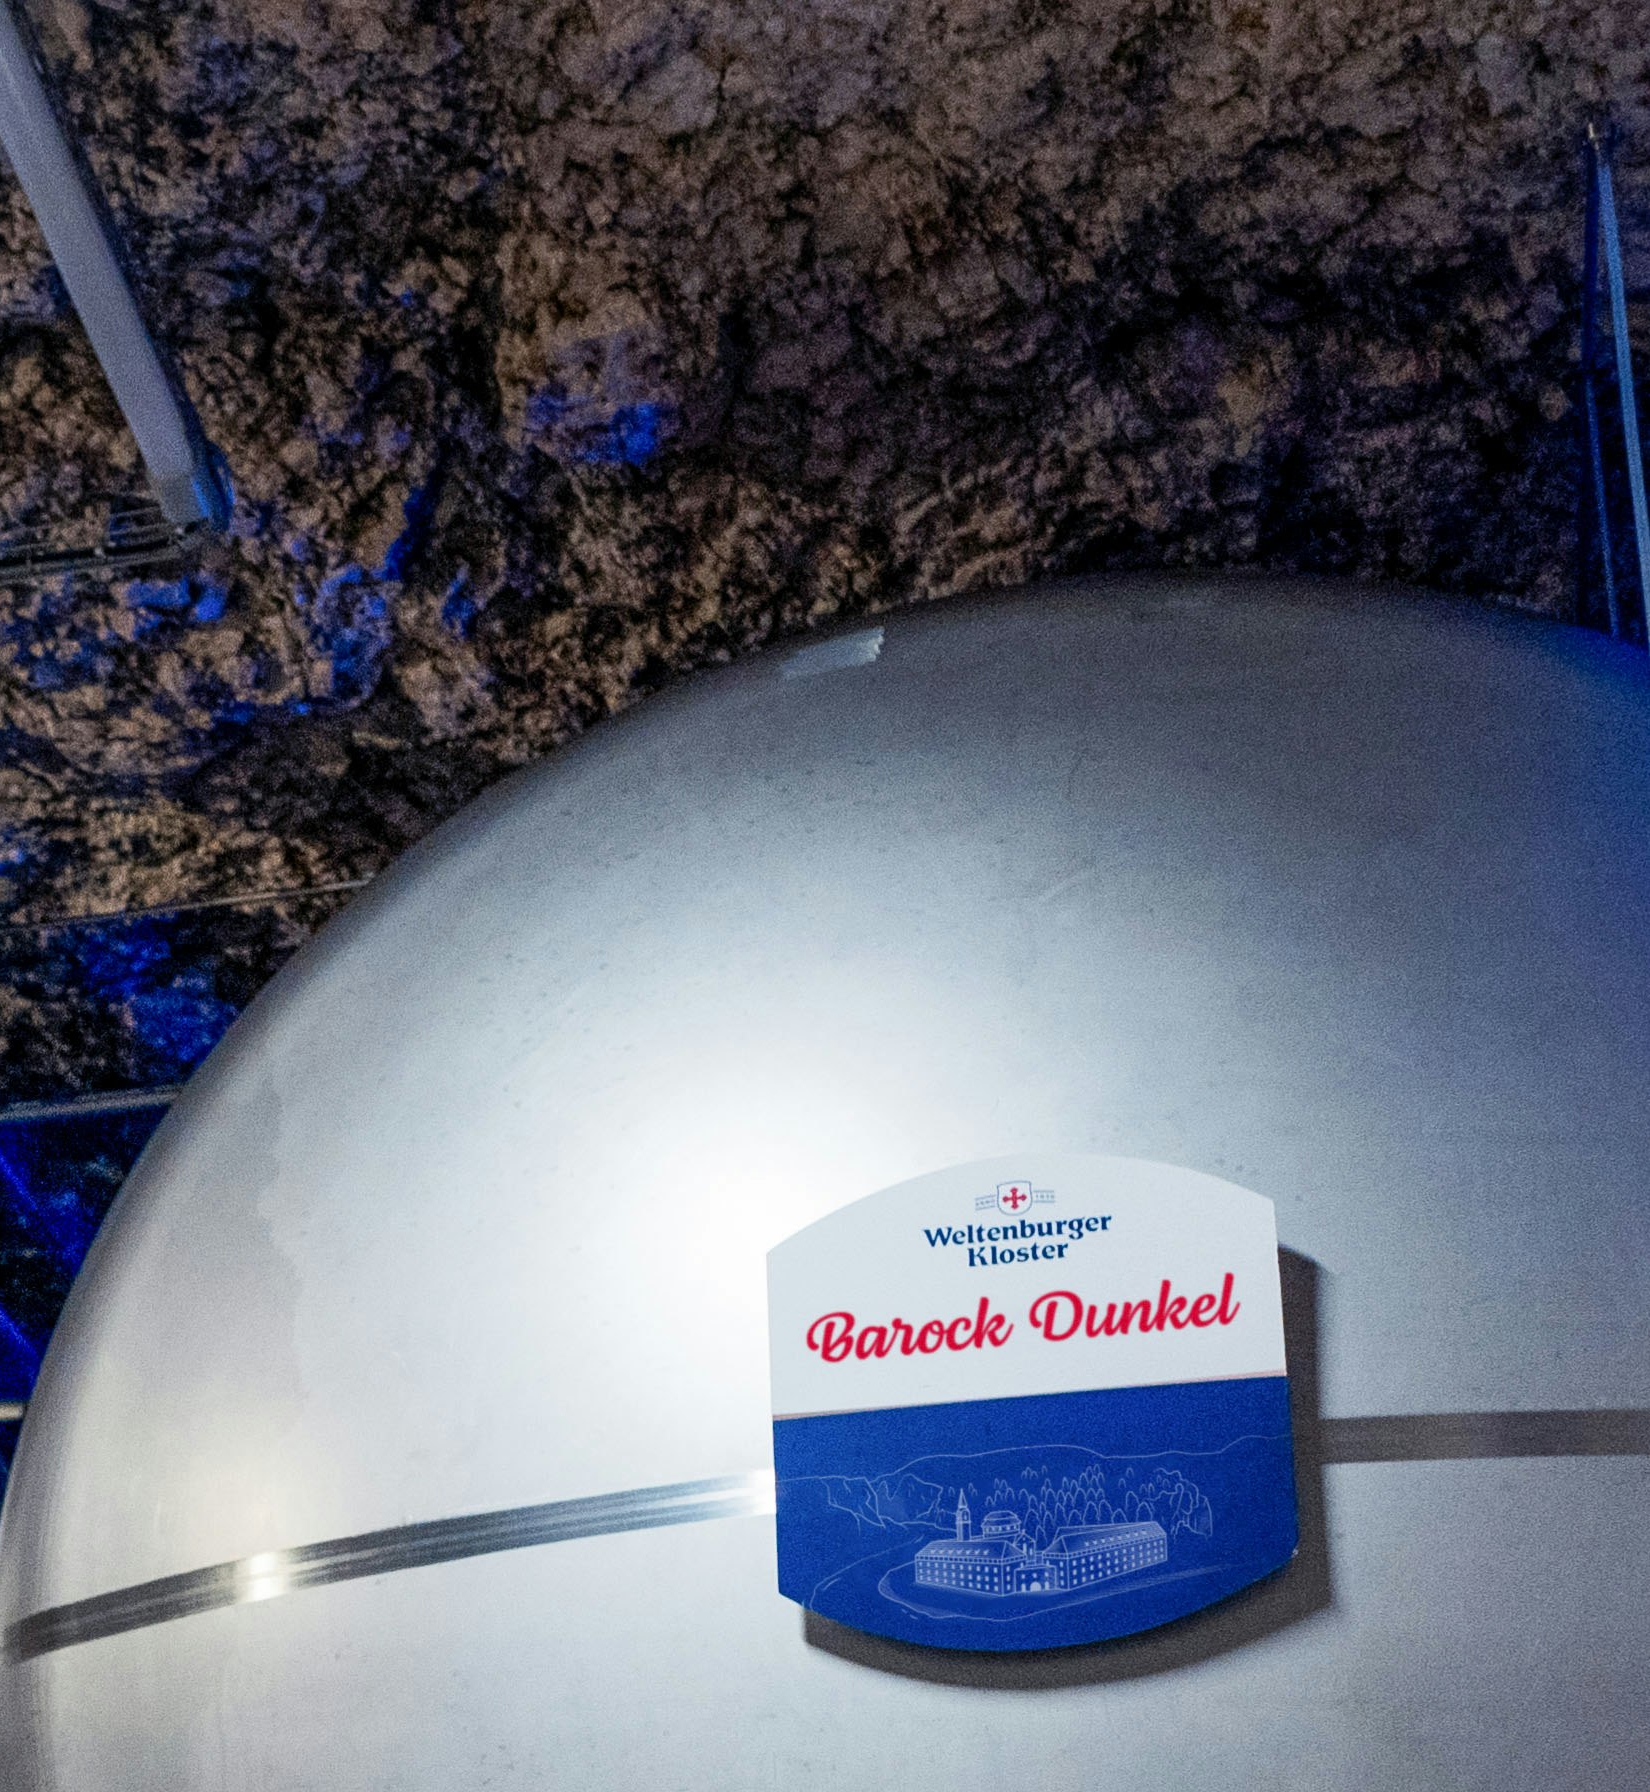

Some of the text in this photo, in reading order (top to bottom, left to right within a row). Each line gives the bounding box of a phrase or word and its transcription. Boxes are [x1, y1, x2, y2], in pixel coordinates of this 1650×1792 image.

[923, 1215, 1112, 1248] Weltenburger
[967, 1242, 1069, 1267] Kloster
[806, 1272, 1241, 1363] Barock Dunkel
